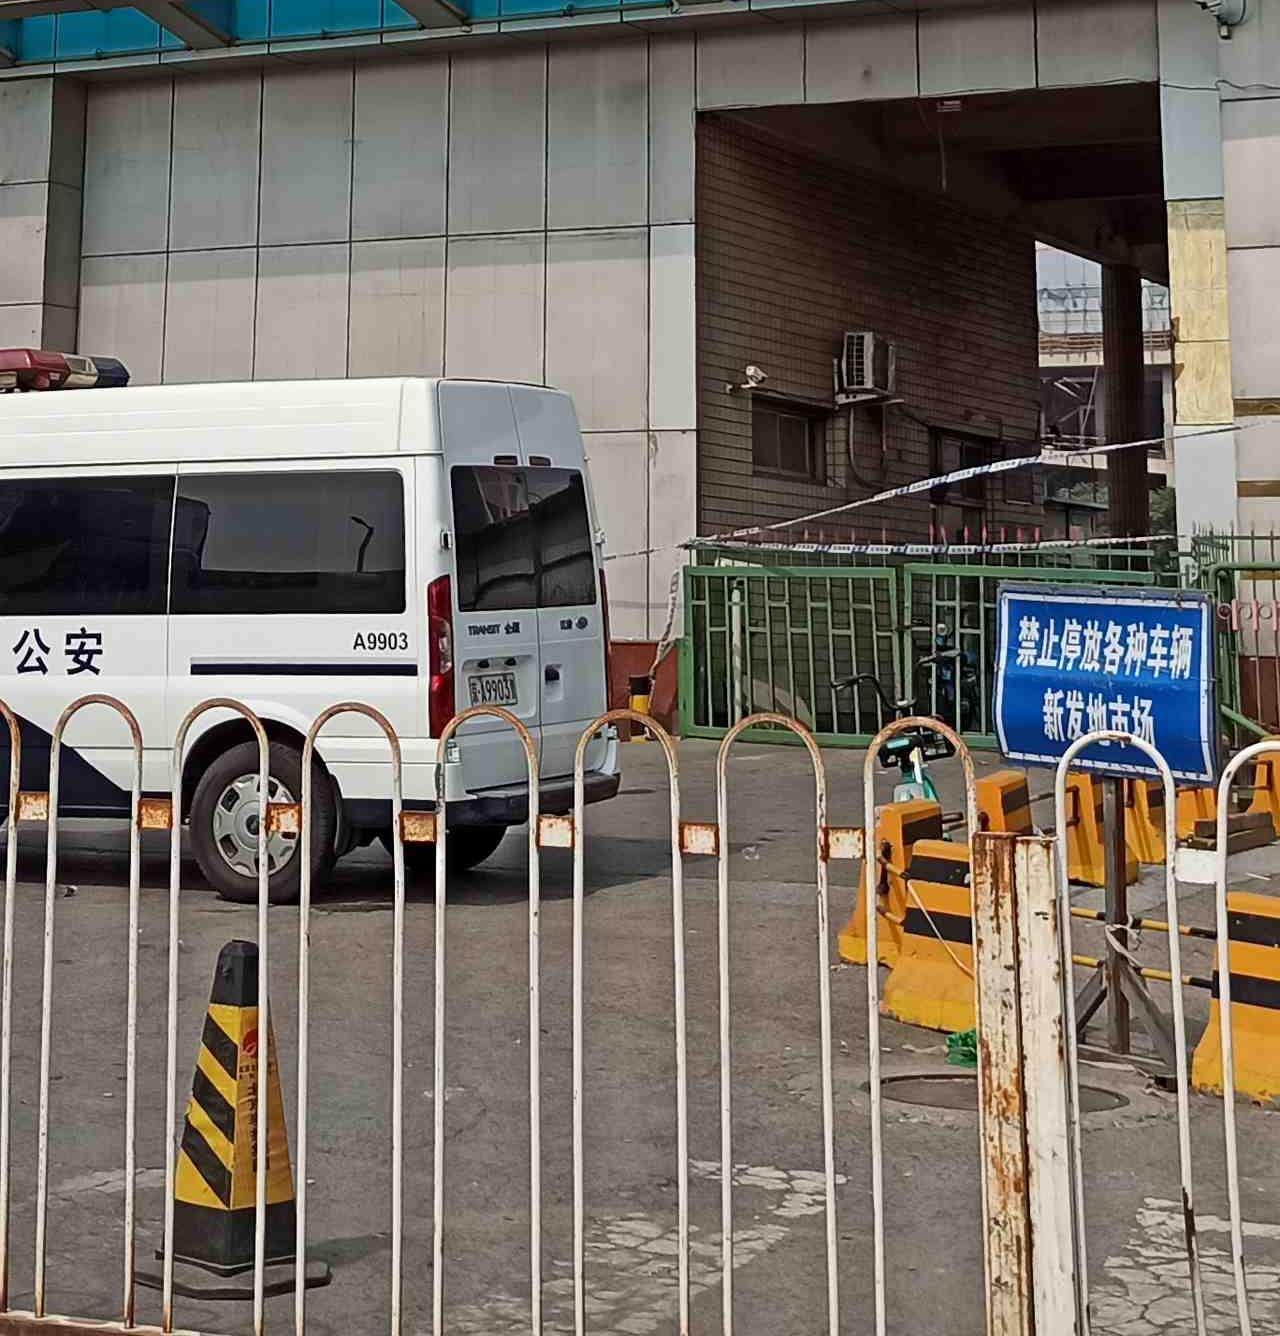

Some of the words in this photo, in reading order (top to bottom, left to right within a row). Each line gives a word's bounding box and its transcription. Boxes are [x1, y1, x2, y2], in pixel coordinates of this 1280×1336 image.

[12, 627, 104, 676] 公安
[353, 632, 409, 651] A9903
[1015, 615, 1194, 680] 禁止停放各种车辆
[1042, 688, 1156, 749] 新发地市场
